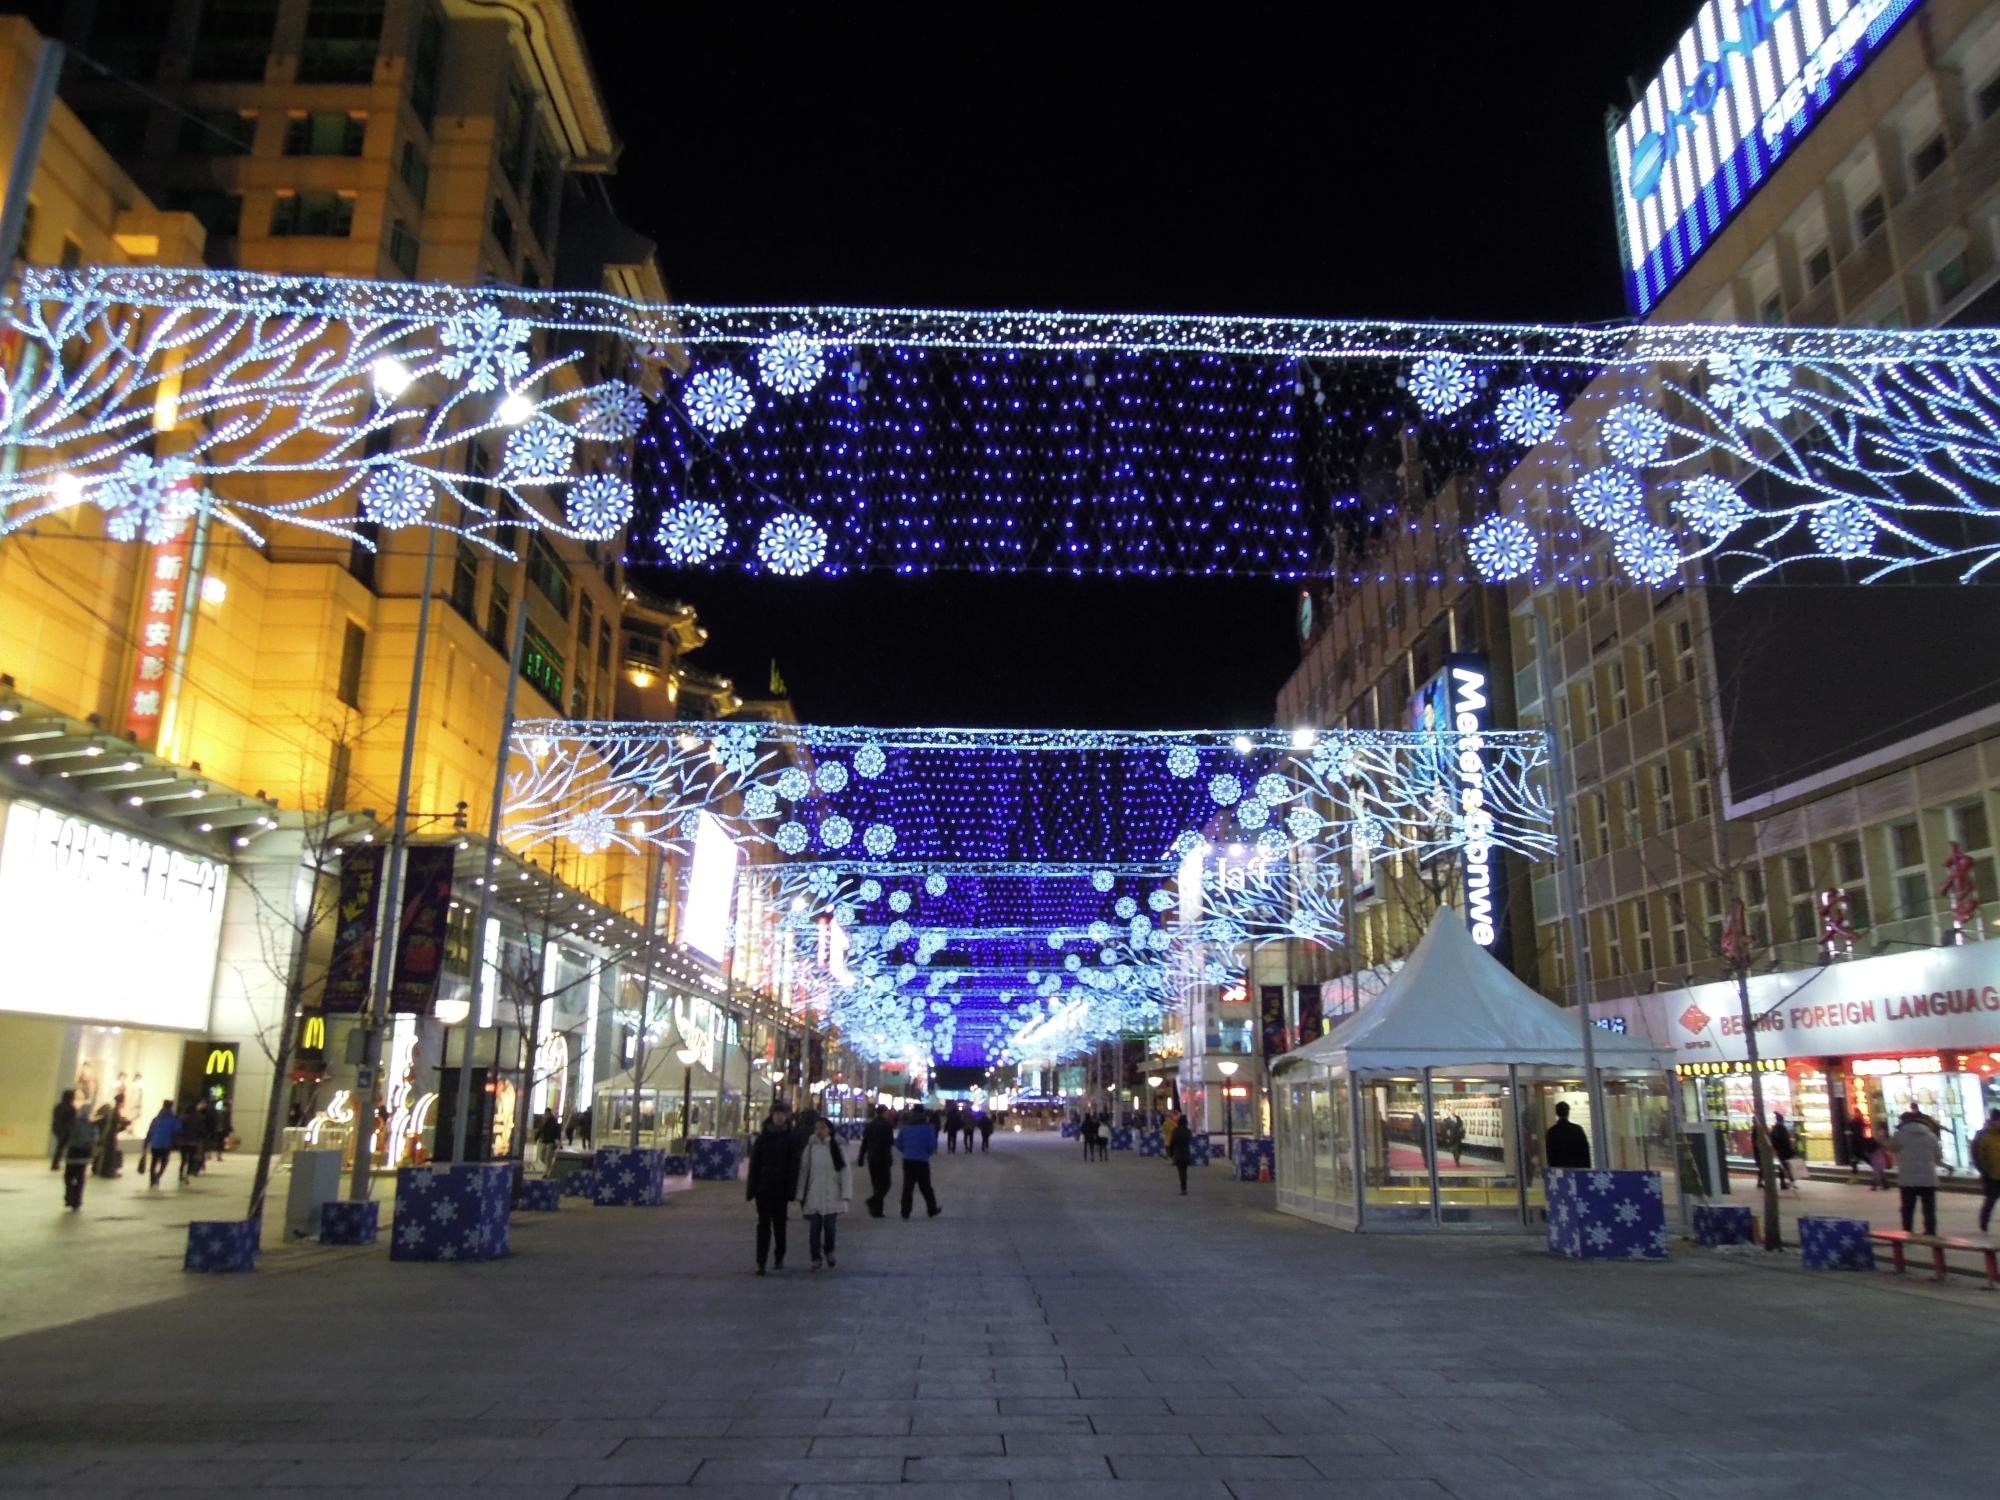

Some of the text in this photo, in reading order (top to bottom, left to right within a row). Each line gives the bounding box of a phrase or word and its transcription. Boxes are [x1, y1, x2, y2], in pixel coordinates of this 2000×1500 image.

[1720, 985, 2000, 1036] BEIING FOREIGN LANGUAG
